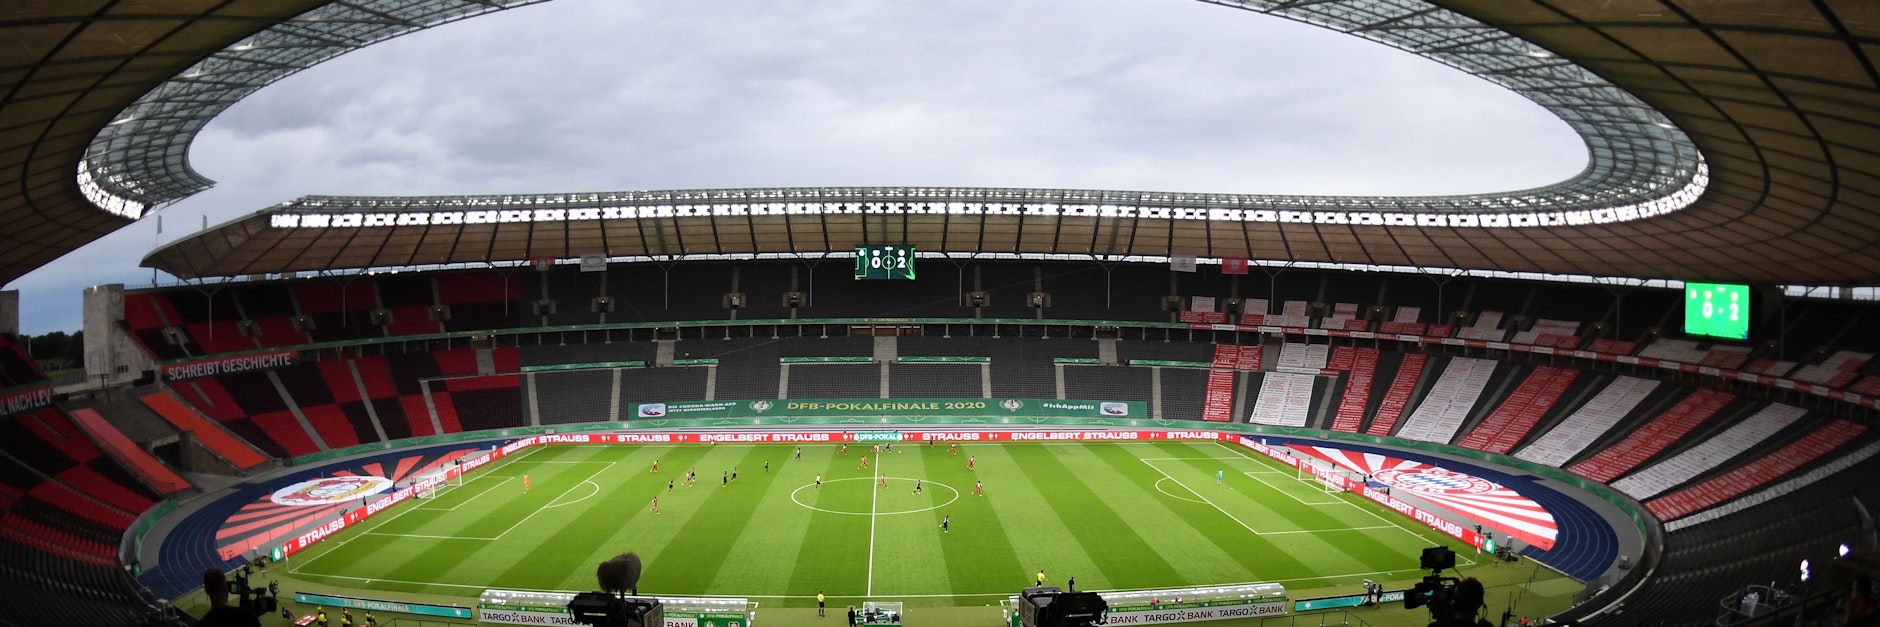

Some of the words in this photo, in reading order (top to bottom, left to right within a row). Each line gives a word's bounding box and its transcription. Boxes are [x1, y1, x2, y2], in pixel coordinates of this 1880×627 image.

[872, 257, 880, 268] 0
[897, 257, 906, 268] 2
[1702, 301, 1713, 318] 0
[1729, 303, 1739, 320] 2
[168, 361, 222, 380] SCHREIBT
[222, 351, 291, 374] GESCHICHTE
[7, 392, 33, 415] NACH
[33, 387, 51, 408] LEV
[786, 401, 940, 412] DFB-POKALFINALE
[945, 401, 987, 411] 2020
[1043, 403, 1095, 411] #IchAppMit
[617, 434, 671, 443] STRAUSS
[700, 434, 767, 443] ENGELBERT
[772, 433, 830, 442] STRAUSS
[860, 433, 898, 441] DFB-POKAL
[922, 433, 980, 442] STRAUSS
[1010, 432, 1081, 441] ENGELBERT
[1083, 432, 1138, 440] STRAUSS
[1167, 431, 1219, 440] STRAUSS
[502, 436, 537, 456] ENGELBERT
[539, 434, 590, 444] STRAUSS
[1240, 436, 1268, 455] ENGELBERT
[1269, 449, 1297, 467] STRAUSS
[462, 454, 491, 472] STRAUSS
[367, 486, 414, 515] ENGELBERT
[1363, 486, 1413, 516] ENGELBERT
[1415, 508, 1463, 538] STRAUSS
[299, 518, 345, 547] STRAUSS
[483, 612, 512, 622] TARGO
[521, 615, 546, 624] BANK
[1110, 615, 1139, 624] BANK
[1144, 612, 1177, 622] TARGO
[1187, 610, 1214, 620] BANK
[1219, 608, 1250, 618] TARGO
[1259, 605, 1284, 614] BANK
